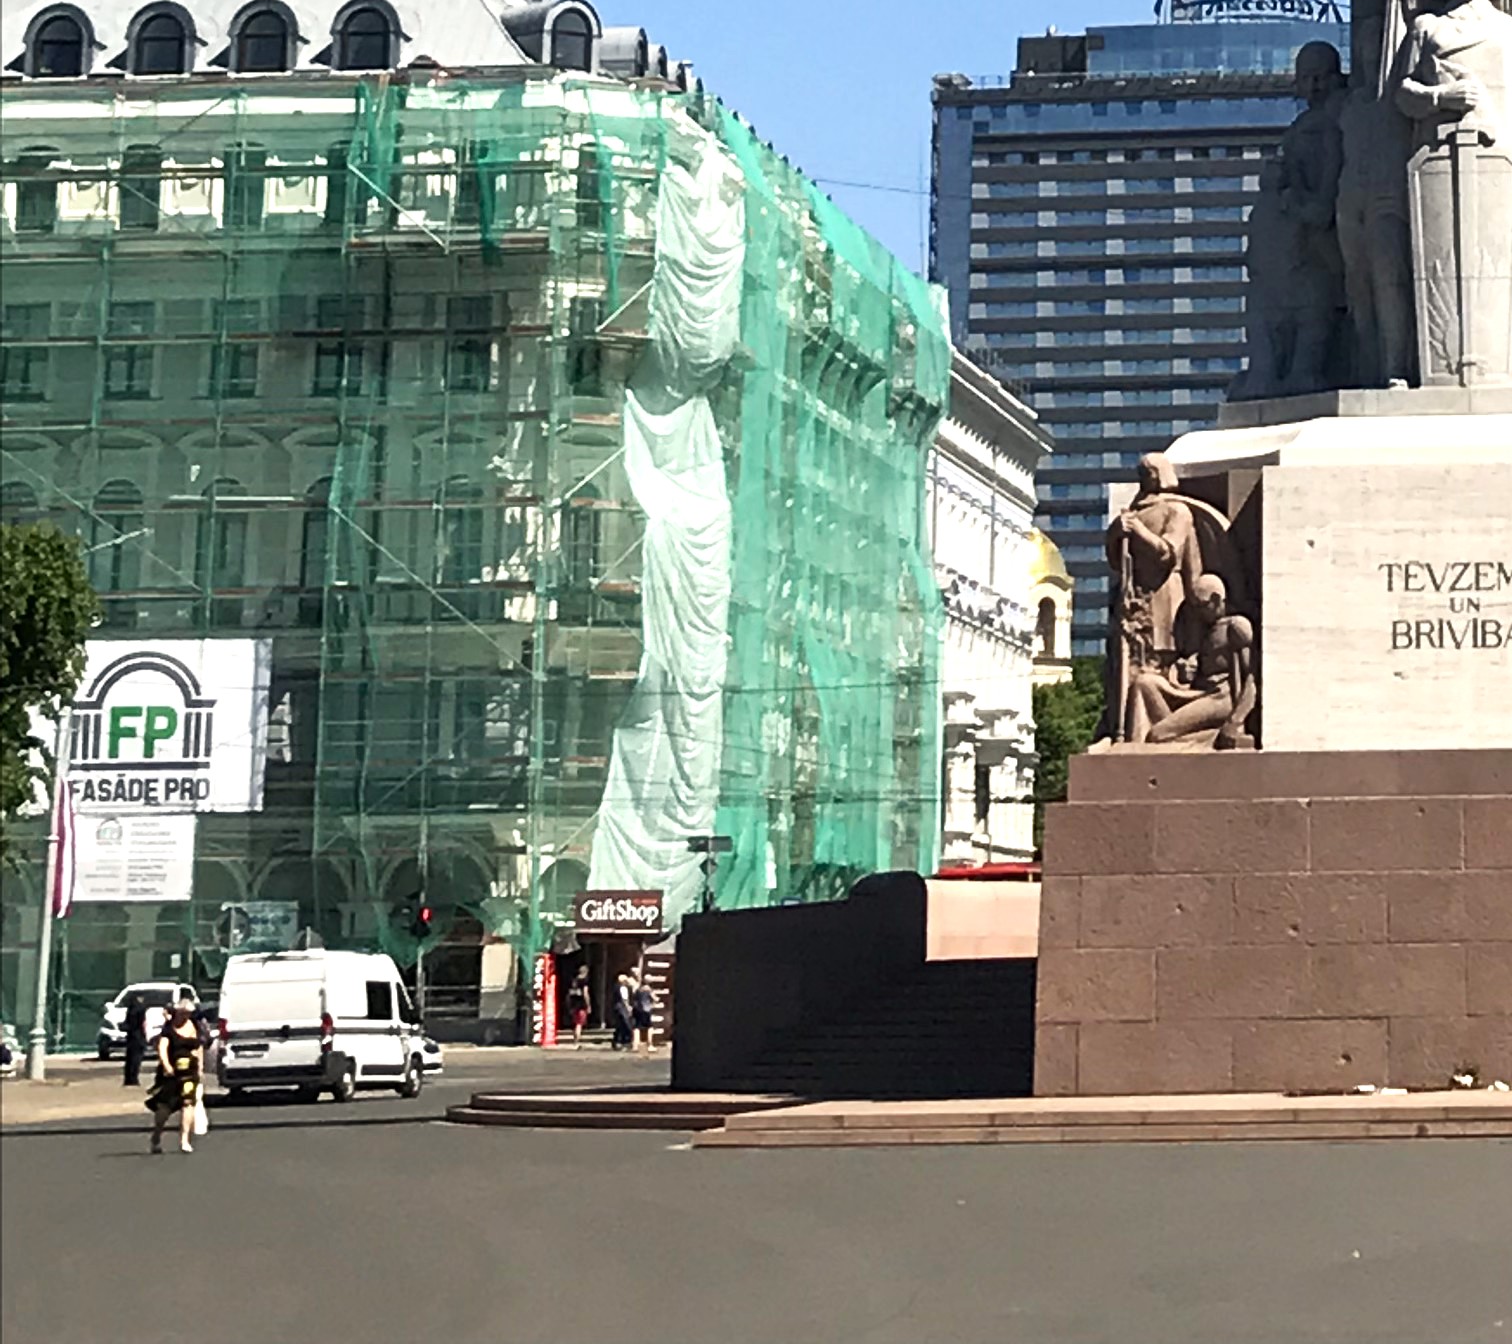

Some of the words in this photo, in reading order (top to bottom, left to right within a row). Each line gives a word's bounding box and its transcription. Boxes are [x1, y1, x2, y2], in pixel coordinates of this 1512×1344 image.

[1449, 597, 1480, 613] UN
[108, 706, 178, 758] FP
[165, 777, 210, 801] PRO
